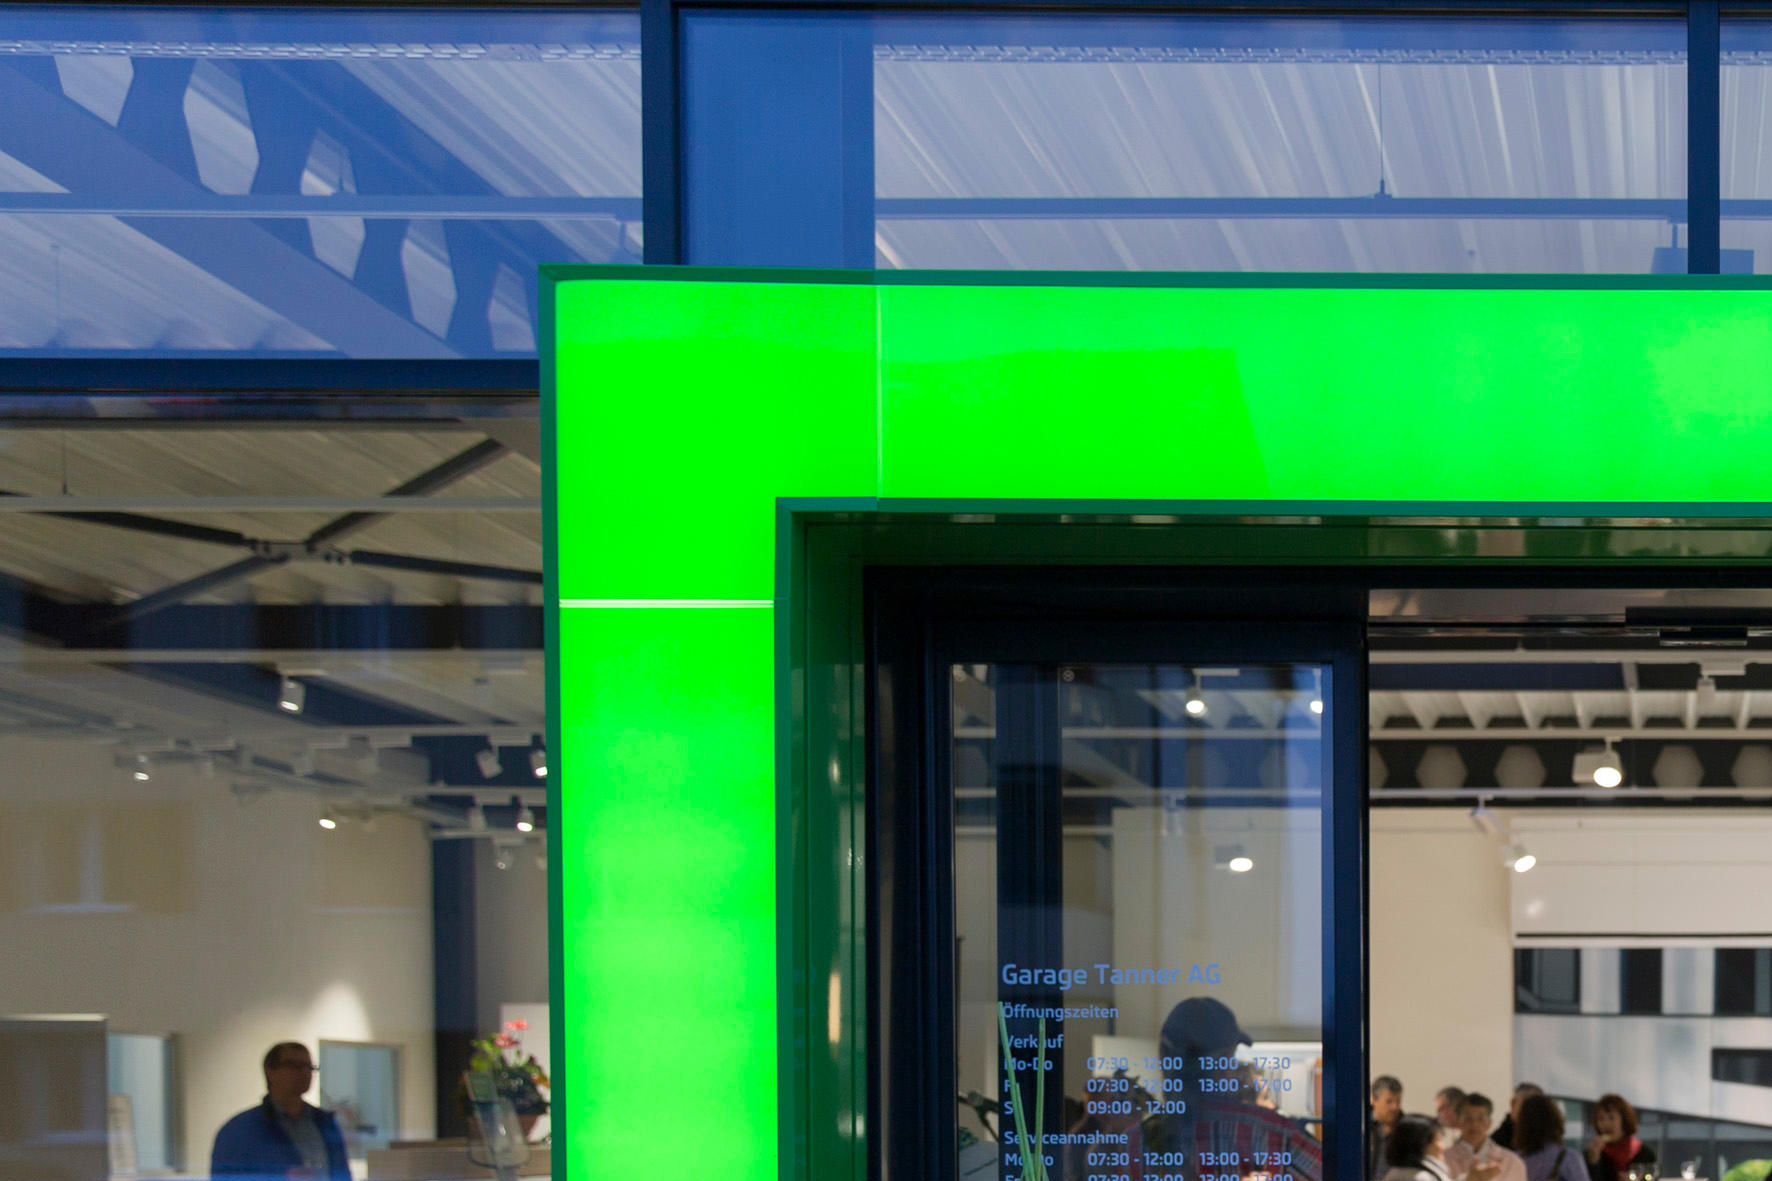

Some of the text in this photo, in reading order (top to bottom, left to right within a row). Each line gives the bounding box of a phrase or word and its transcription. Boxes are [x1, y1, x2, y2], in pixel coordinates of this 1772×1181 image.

[1002, 963, 1221, 990] Garage Tanner AG
[1003, 1002, 1119, 1021] Öffnungszeiten
[1086, 1057, 1129, 1071] 07:30
[1143, 1057, 1183, 1071] 12:00
[1199, 1057, 1239, 1071] 13:00
[1253, 1057, 1290, 1071] 17:30
[1086, 1079, 1129, 1093] 07:30
[1143, 1079, 1183, 1093] 12:00
[1199, 1079, 1239, 1093] 13:00
[1253, 1079, 1292, 1093] 17:00
[1087, 1101, 1132, 1115] 09:00
[1146, 1101, 1186, 1115] 12:00
[1087, 1152, 1130, 1166] 07:30
[1144, 1152, 1184, 1166] 12:00
[1200, 1152, 1240, 1166] 13:00
[1254, 1152, 1291, 1166] 17:30
